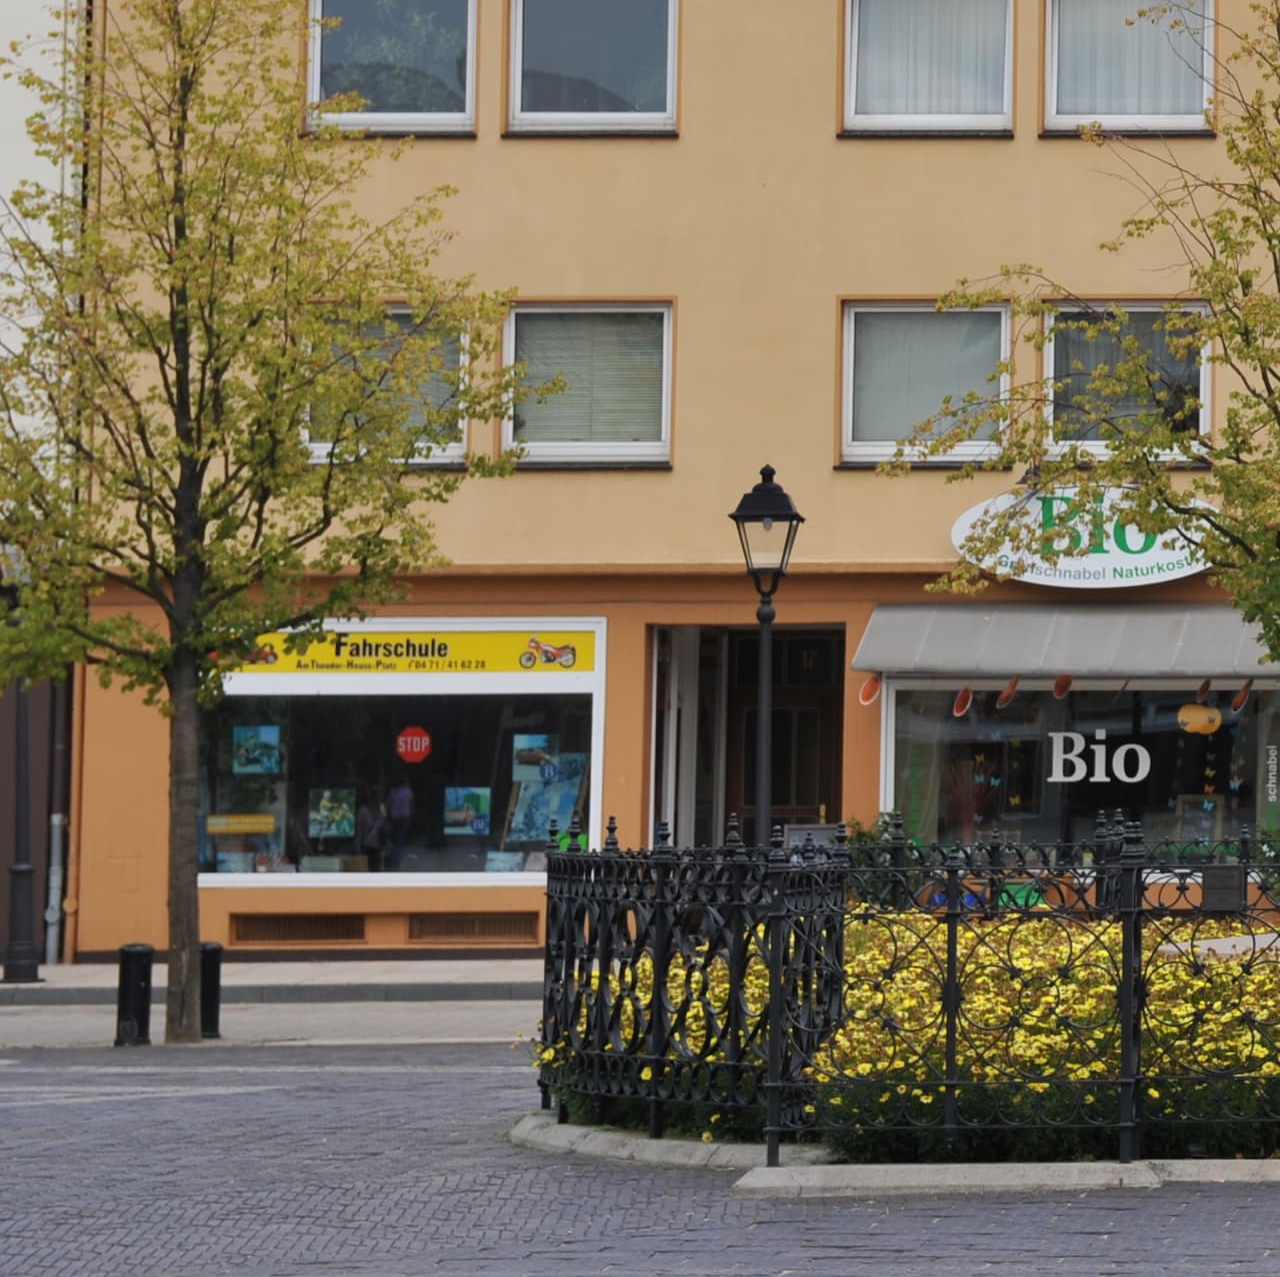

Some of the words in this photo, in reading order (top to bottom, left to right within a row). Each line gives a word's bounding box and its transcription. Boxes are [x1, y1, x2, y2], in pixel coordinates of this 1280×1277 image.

[1036, 496, 1158, 555] Bio
[998, 554, 1106, 580] Grnschnabel
[1112, 555, 1193, 579] Naturkost
[335, 633, 448, 657] Fahrschule
[398, 737, 430, 753] STOP
[1047, 728, 1151, 783] Bio
